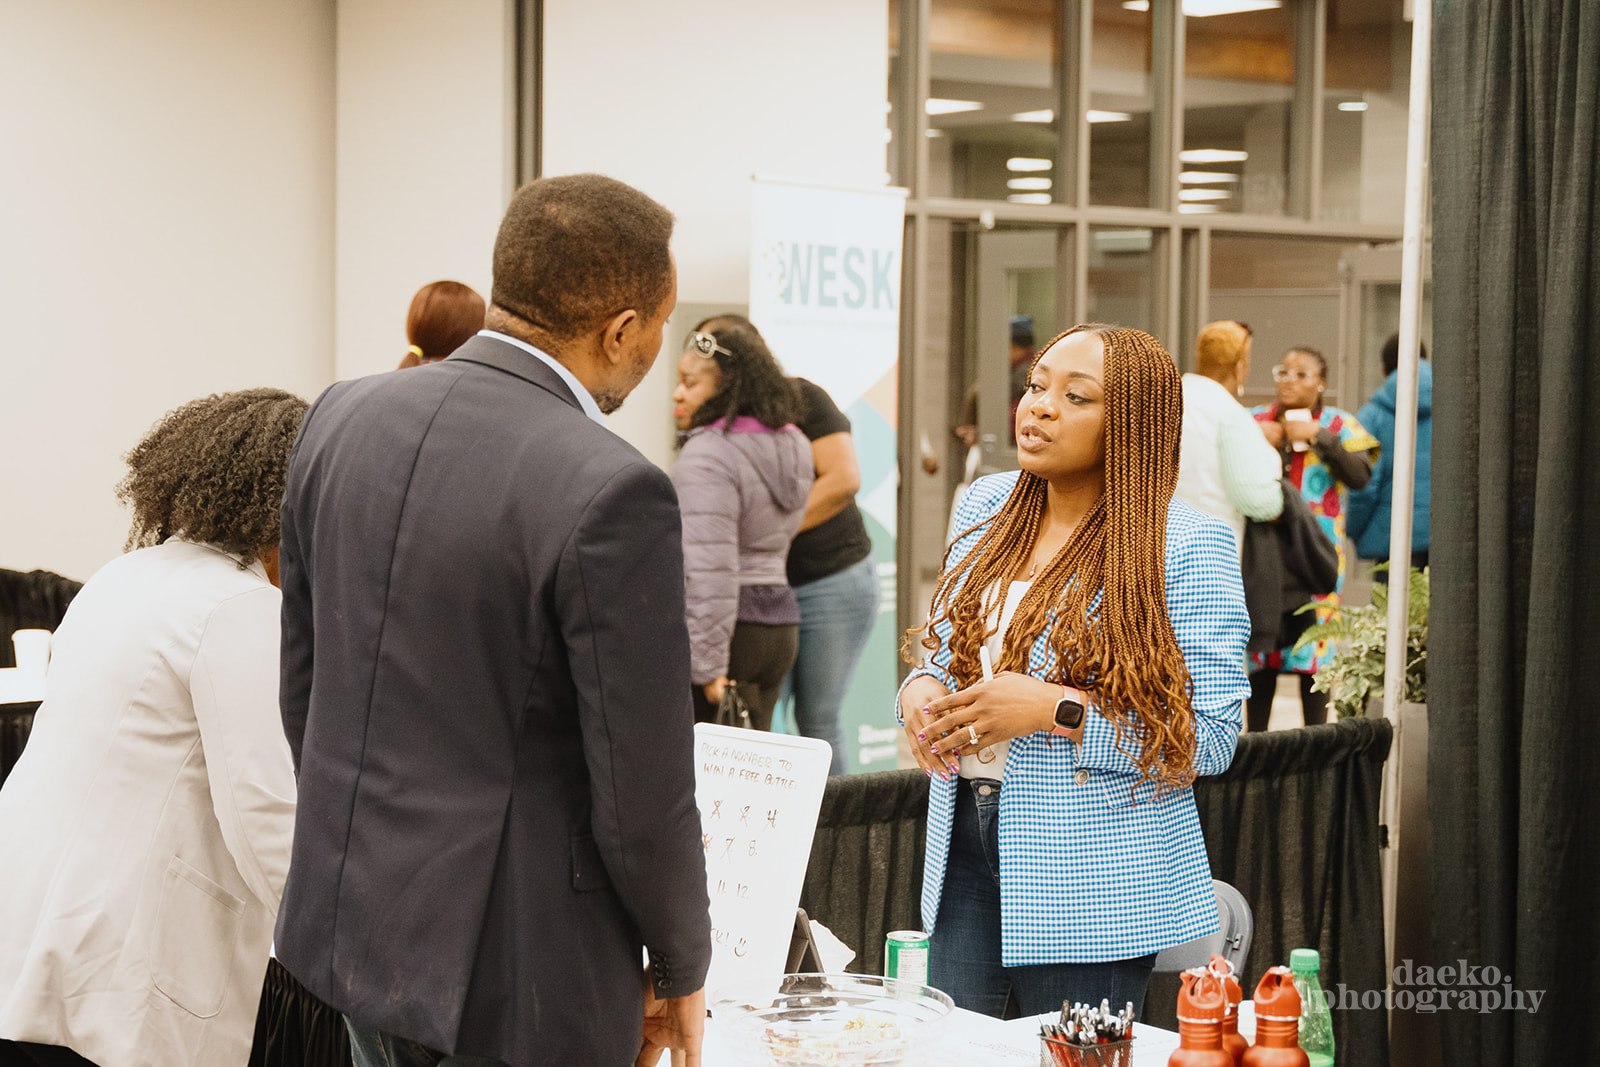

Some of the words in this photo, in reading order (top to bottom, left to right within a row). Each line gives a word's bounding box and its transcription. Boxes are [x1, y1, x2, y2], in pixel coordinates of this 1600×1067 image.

[722, 747, 729, 759] A
[731, 750, 773, 768] NUMBER
[779, 759, 793, 772] TO
[703, 763, 725, 775] WIN
[729, 767, 736, 778] A
